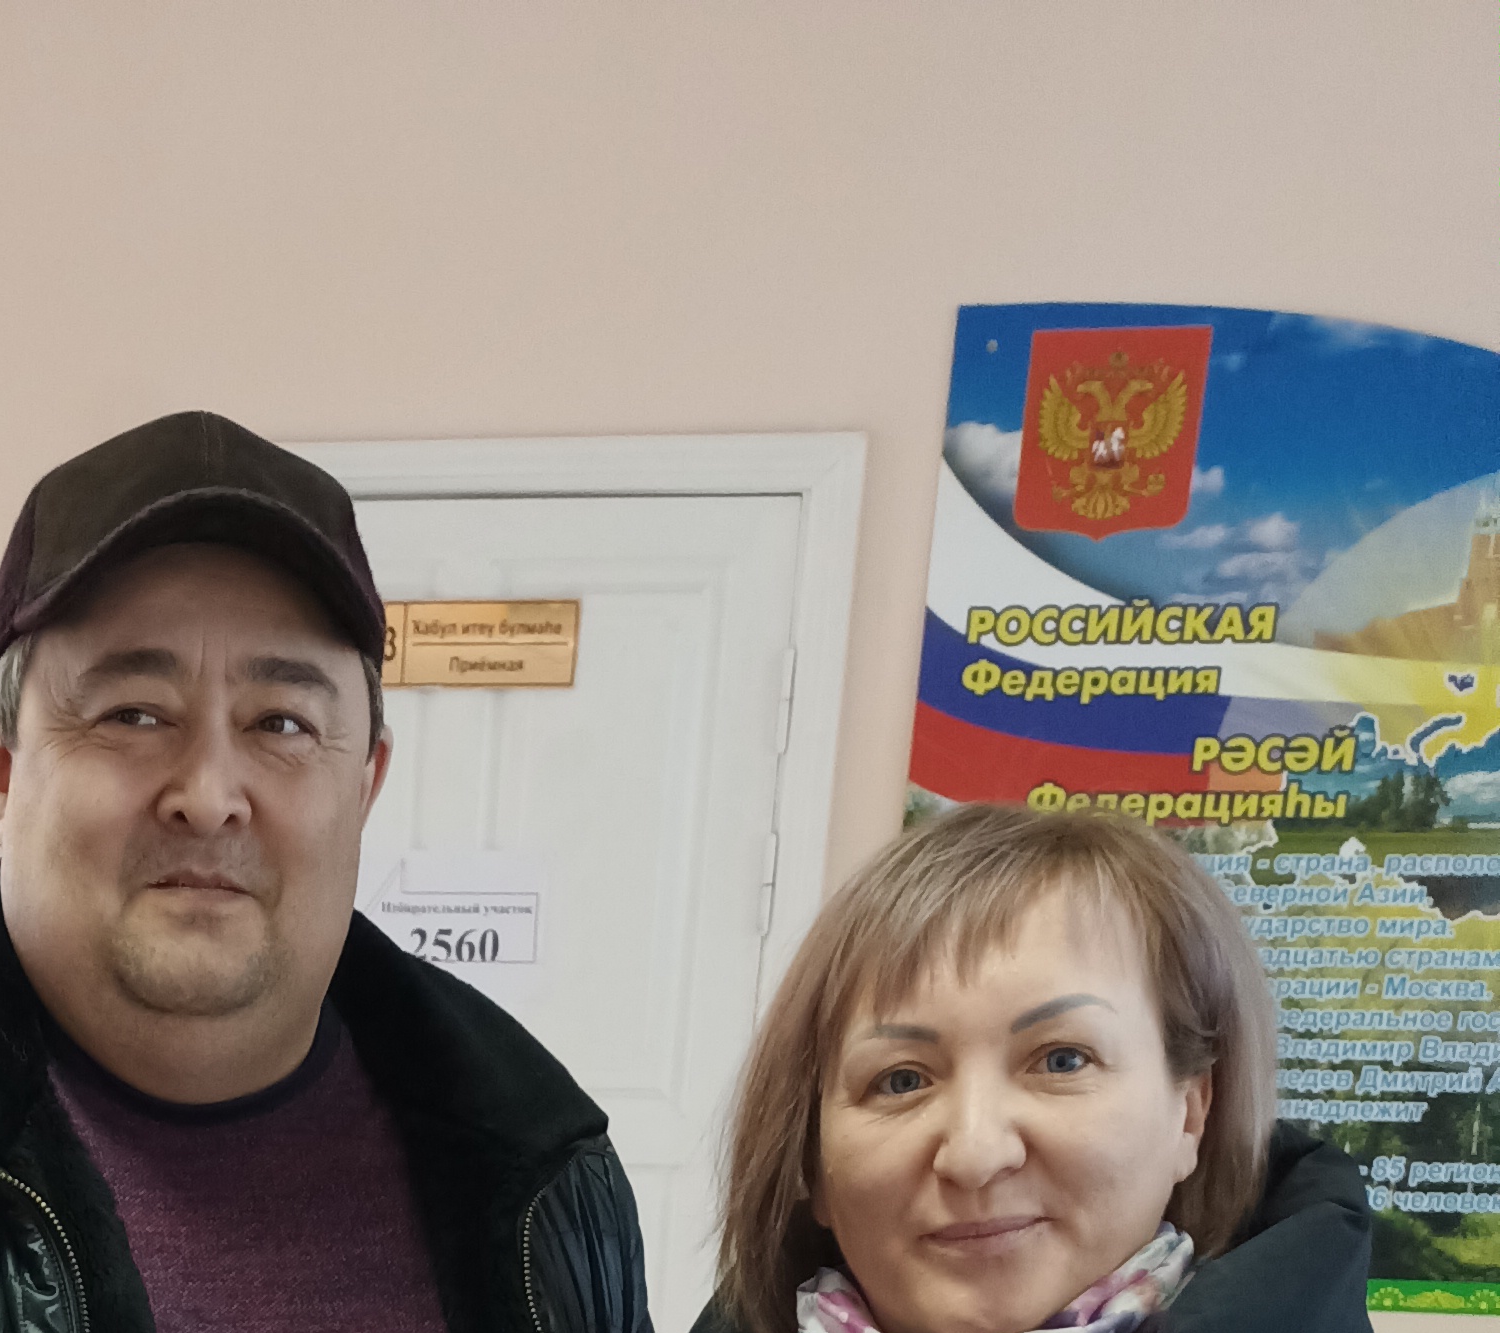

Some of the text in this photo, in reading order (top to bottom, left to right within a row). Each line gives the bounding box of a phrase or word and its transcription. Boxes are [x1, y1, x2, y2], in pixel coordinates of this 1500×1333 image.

[966, 600, 1277, 645] РОССИЙСКАЯ
[962, 659, 1220, 703] Федерация
[1190, 725, 1357, 775] РӘСӘЙ
[1222, 883, 1349, 907] еверной
[410, 928, 499, 962] 2560
[1268, 977, 1359, 998] рации
[1357, 1066, 1483, 1097] Дмитрий
[1372, 1156, 1406, 1180] 85
